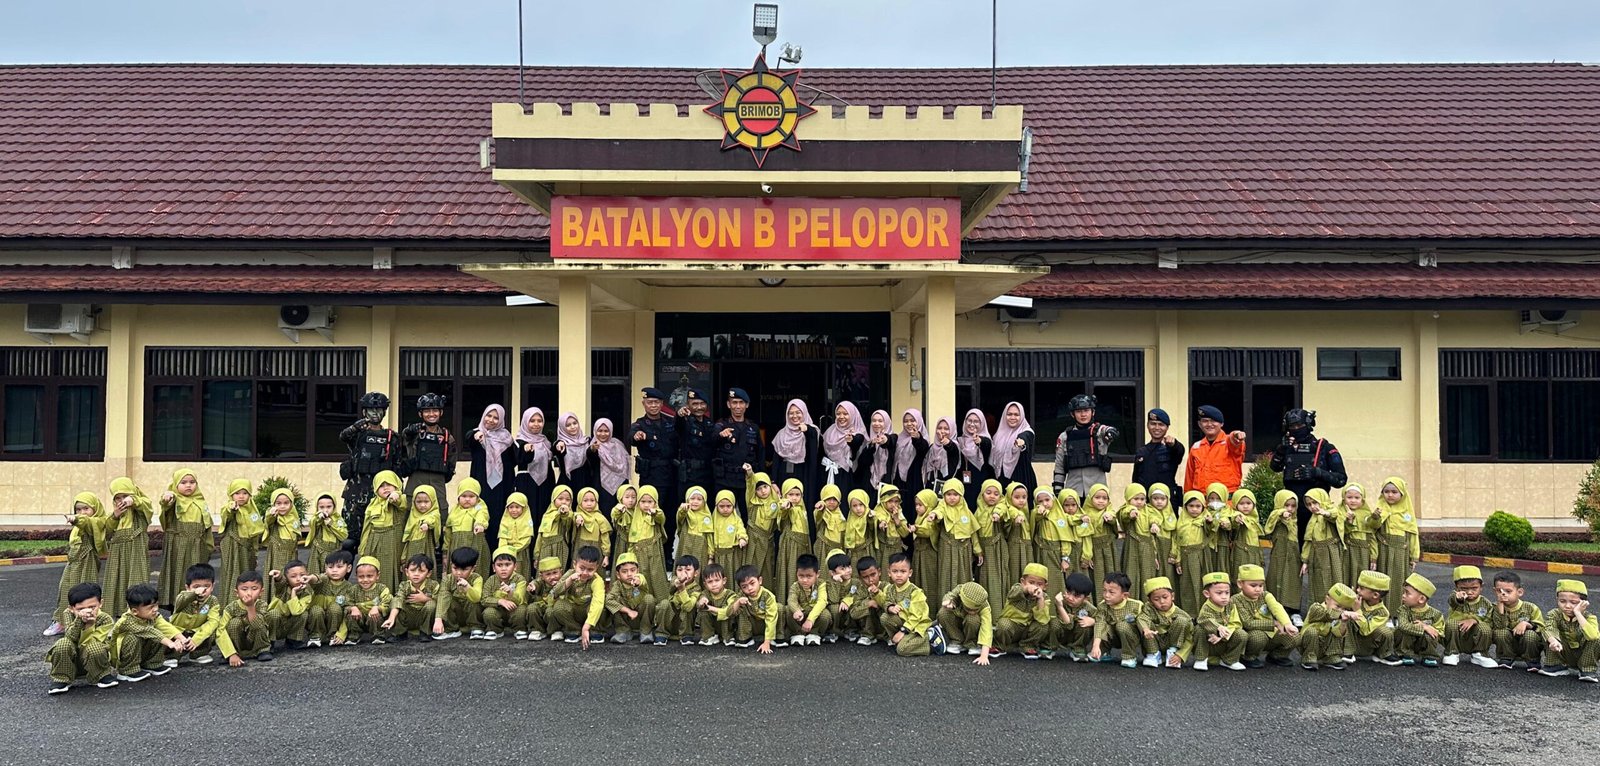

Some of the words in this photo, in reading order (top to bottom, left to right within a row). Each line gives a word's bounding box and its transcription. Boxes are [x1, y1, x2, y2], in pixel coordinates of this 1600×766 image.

[740, 105, 780, 117] BRIMOB
[562, 206, 741, 248] BATALYON
[754, 207, 776, 248] B
[788, 207, 950, 248] PELOPOR
